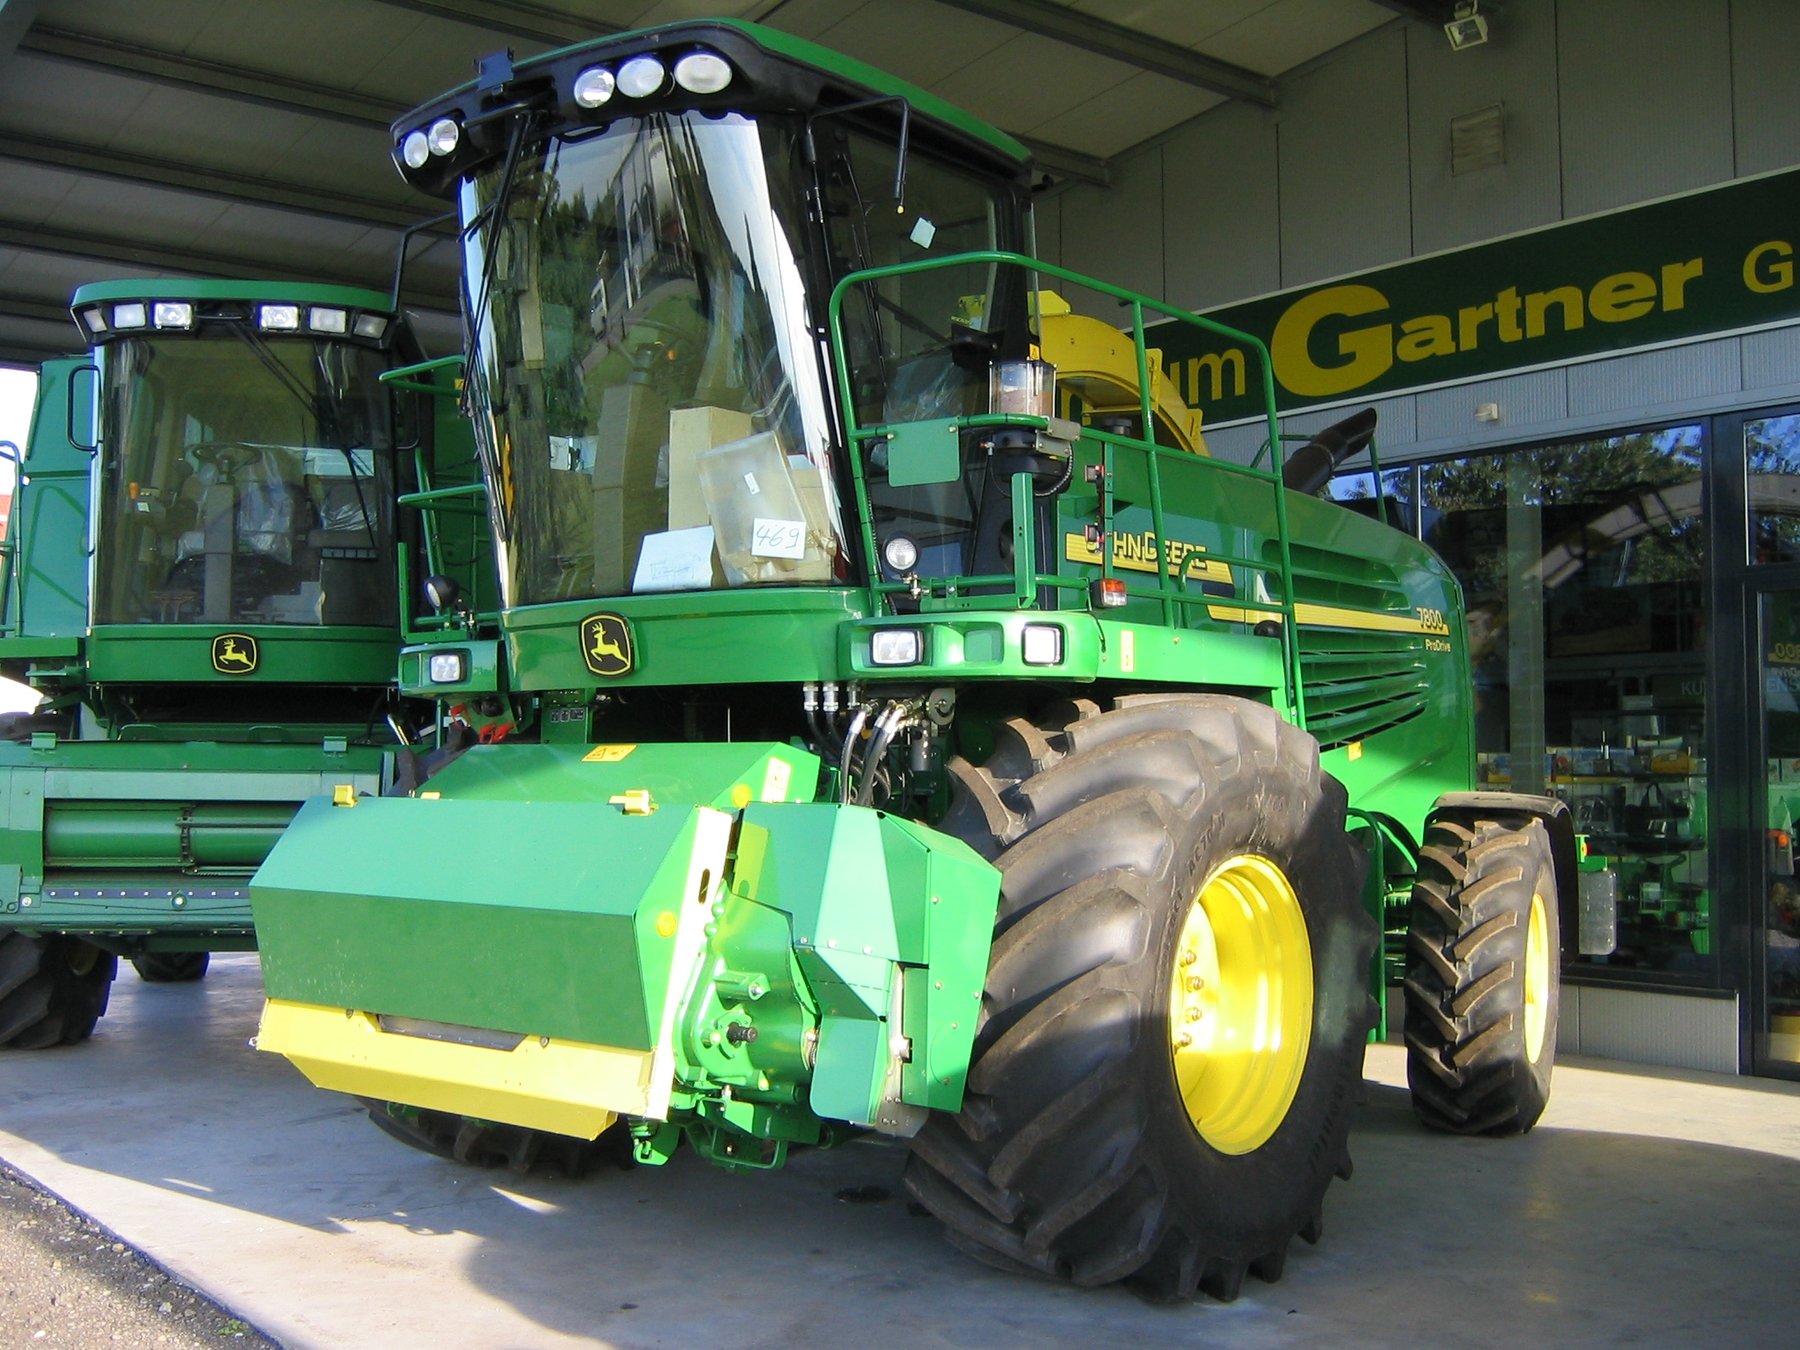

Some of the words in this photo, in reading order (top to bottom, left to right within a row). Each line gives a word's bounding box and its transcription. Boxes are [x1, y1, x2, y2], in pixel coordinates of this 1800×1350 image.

[1271, 257, 1703, 397] Gartner
[756, 524, 800, 549] 469
[1416, 606, 1444, 630] 7800
